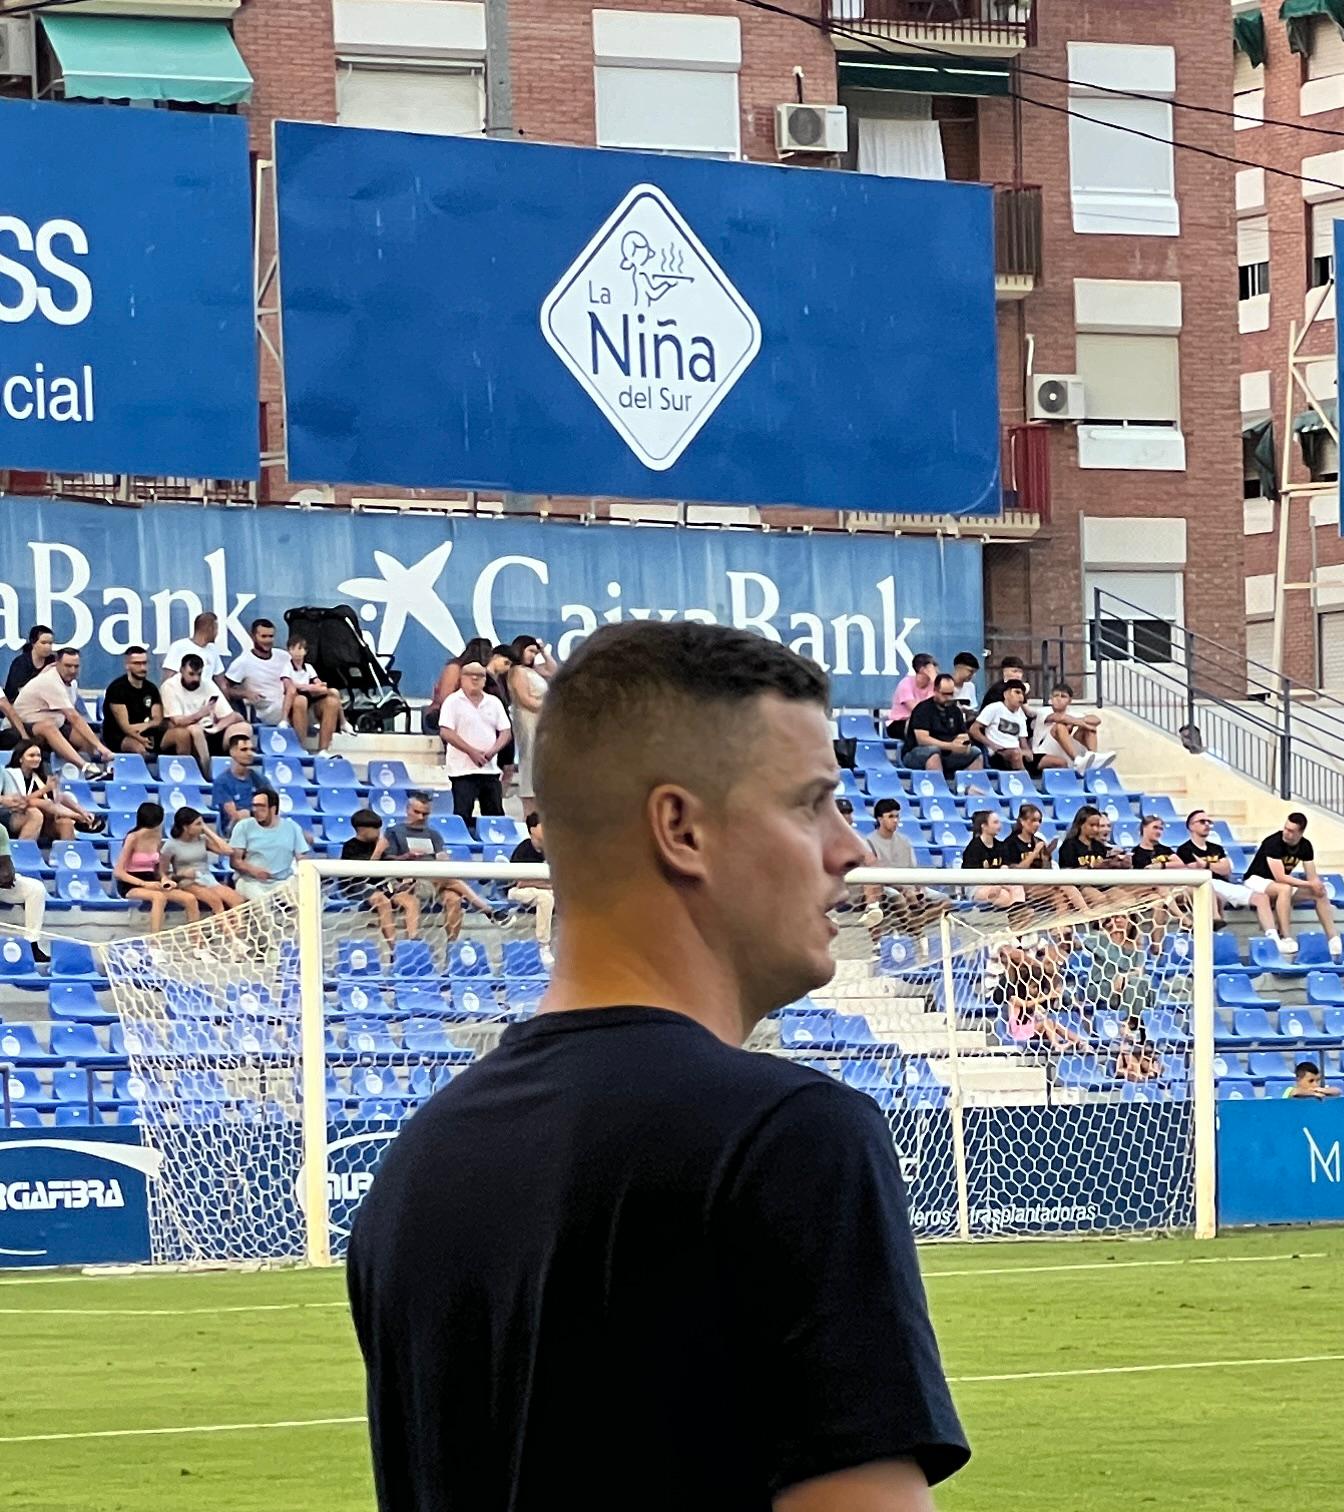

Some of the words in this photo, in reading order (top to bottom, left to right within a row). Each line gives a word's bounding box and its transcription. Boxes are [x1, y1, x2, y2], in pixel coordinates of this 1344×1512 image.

[589, 280, 611, 304] La
[587, 311, 716, 382] Niña
[619, 385, 652, 409] del
[660, 387, 692, 411] Sur
[472, 555, 921, 676] CaiBank
